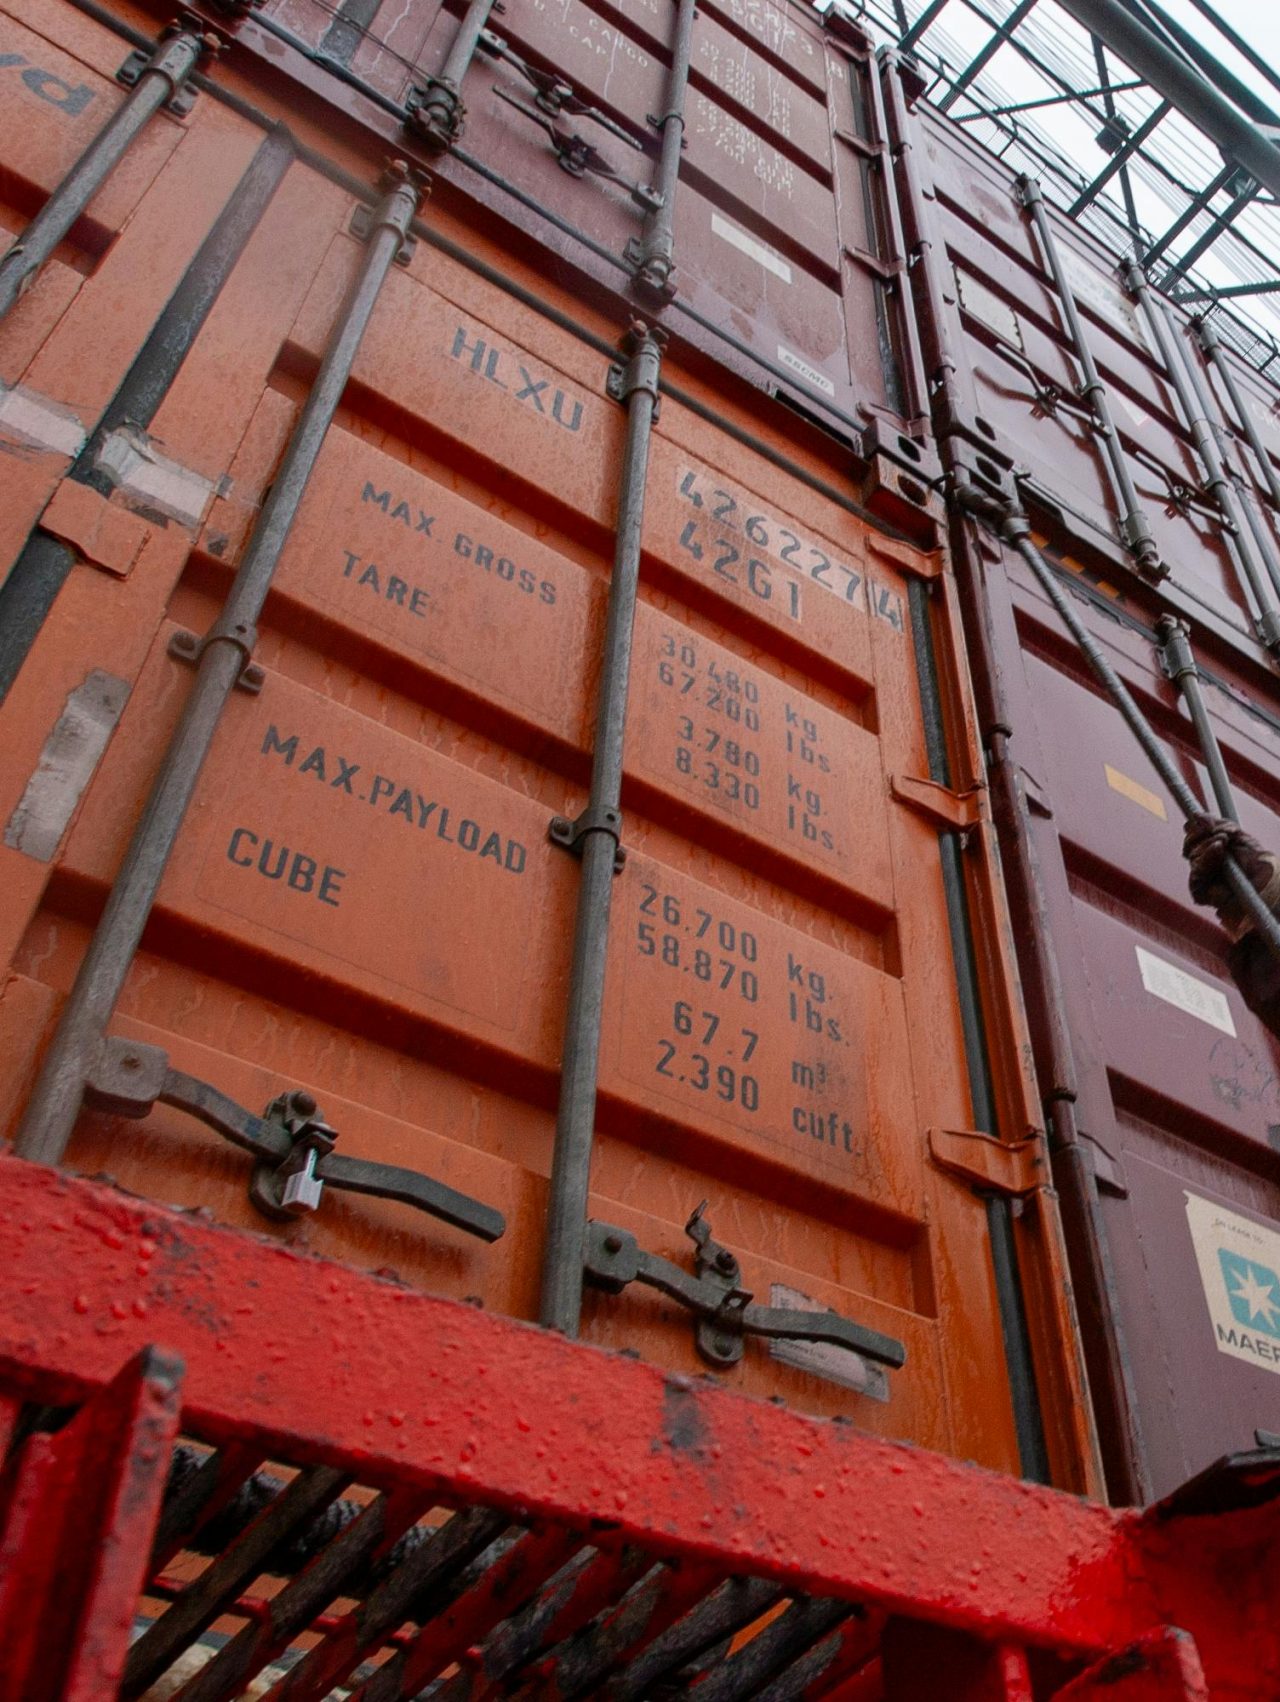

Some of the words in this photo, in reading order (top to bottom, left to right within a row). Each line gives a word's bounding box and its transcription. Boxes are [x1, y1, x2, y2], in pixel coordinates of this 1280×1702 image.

[451, 326, 584, 432] HLXU
[453, 532, 557, 605] GROSS
[679, 521, 799, 619] 42G1
[680, 471, 861, 601] 426227
[341, 550, 431, 619] TARE
[675, 748, 760, 810] 8.330
[678, 716, 760, 777] 3.780
[226, 828, 347, 907] CUBE
[639, 884, 758, 963] 26.700
[638, 922, 759, 1003] 58.870
[674, 1001, 759, 1062] 67.7
[655, 1039, 759, 1112] 2.390
